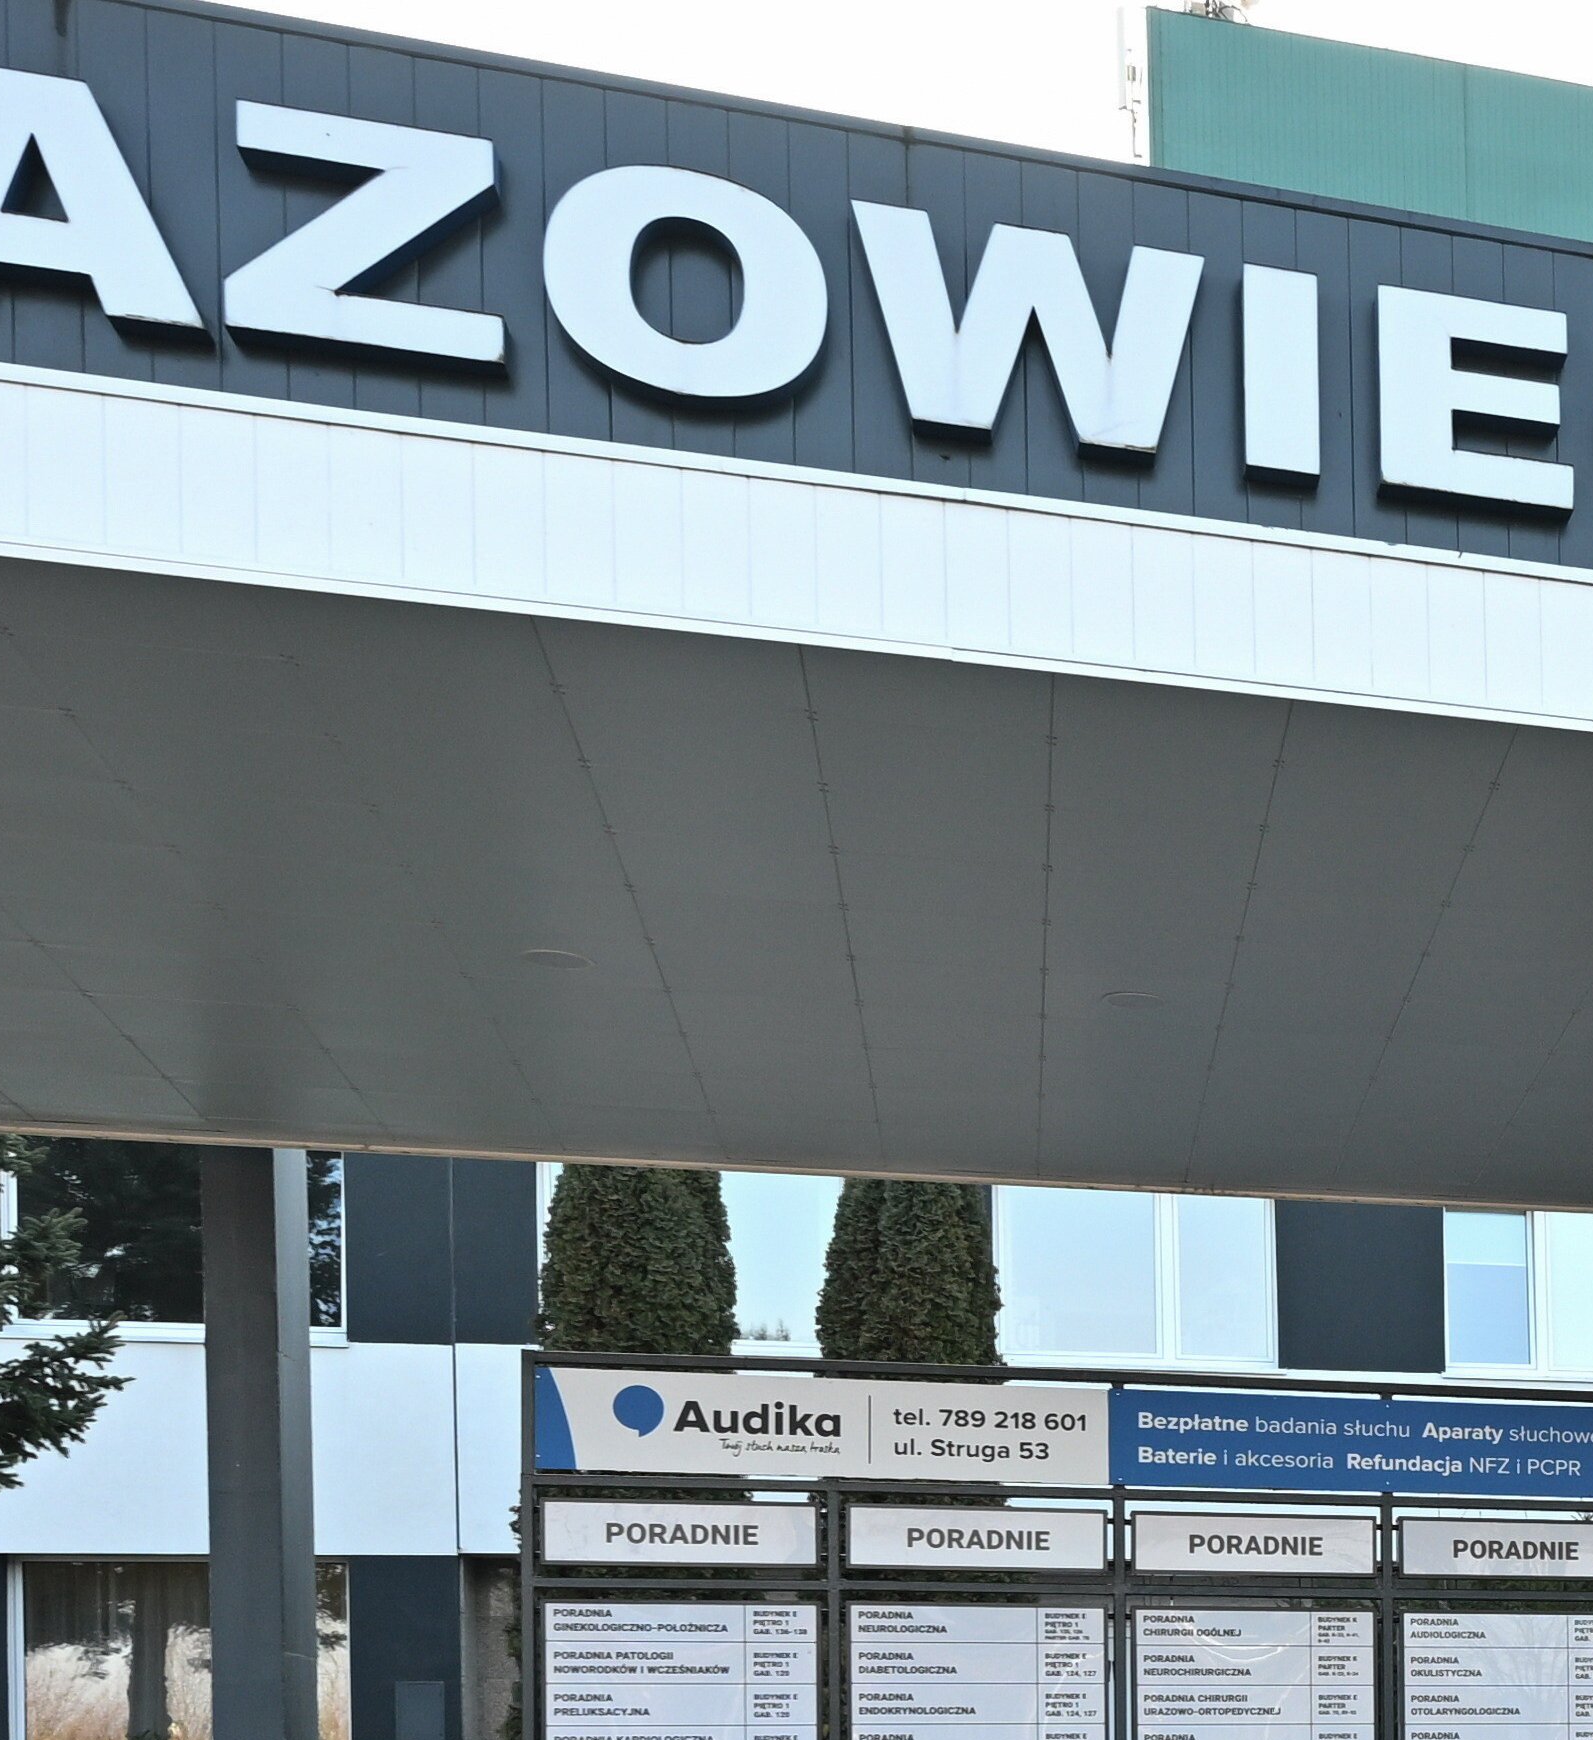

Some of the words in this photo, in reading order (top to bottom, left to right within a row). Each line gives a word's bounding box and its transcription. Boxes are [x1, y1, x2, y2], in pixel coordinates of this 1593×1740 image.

[673, 1401, 841, 1437] Audika
[893, 1408, 930, 1426] tel.
[939, 1409, 985, 1428] 789
[994, 1411, 1036, 1430] 218
[1044, 1413, 1086, 1431] 601
[1138, 1412, 1249, 1434] Bezpłatne
[1256, 1416, 1337, 1435] badania
[1344, 1420, 1410, 1437] słuchu
[1422, 1422, 1503, 1444] Aparaty
[894, 1438, 922, 1455] ul.
[931, 1439, 1010, 1462] Struga
[1020, 1442, 1049, 1460] 53
[1138, 1446, 1217, 1465] Baterie
[1224, 1449, 1227, 1465] i
[1235, 1450, 1333, 1469] akcesoria
[1347, 1453, 1462, 1476] Refundacja
[1470, 1457, 1510, 1474] NFZ
[1517, 1459, 1520, 1474] i
[1528, 1459, 1581, 1476] PCPR
[606, 1523, 759, 1545] PORADNIE
[907, 1528, 1050, 1551] PORADNIE
[1189, 1534, 1323, 1556] PORADNIE
[1453, 1539, 1579, 1560] PORADNIE
[553, 1609, 613, 1617] PORADNIA
[858, 1625, 948, 1633] NEUROLOGICZNA
[1143, 1628, 1194, 1636] CHIRURGII
[1196, 1627, 1242, 1637] OGÓLNEJ
[1410, 1631, 1486, 1639] AUDIOLOGICZNA
[554, 1651, 613, 1660] PORADNIA
[615, 1651, 674, 1660] PATOLOGII
[554, 1664, 638, 1674] NOWORODKÓW
[647, 1664, 730, 1674] WCZEŚNIAKÓW
[859, 1666, 957, 1674] DIABETOLOGICZNA
[1143, 1668, 1252, 1676] NEUROCHIRURGICZNA
[1411, 1669, 1482, 1677] OKULISTYCZNA
[554, 1694, 613, 1702] PORADNIA
[1144, 1694, 1196, 1702] PORADNIA
[1198, 1694, 1248, 1702] CHIRURGII
[554, 1708, 650, 1716] PRELUKSACYJNA
[859, 1706, 976, 1715] ENDOKRYNOLOGICZNA
[1144, 1707, 1281, 1716] URAZOWO-ORTOPEDYCZNEJ
[1411, 1707, 1520, 1715] OTOLARYNGOLOGICZNA
